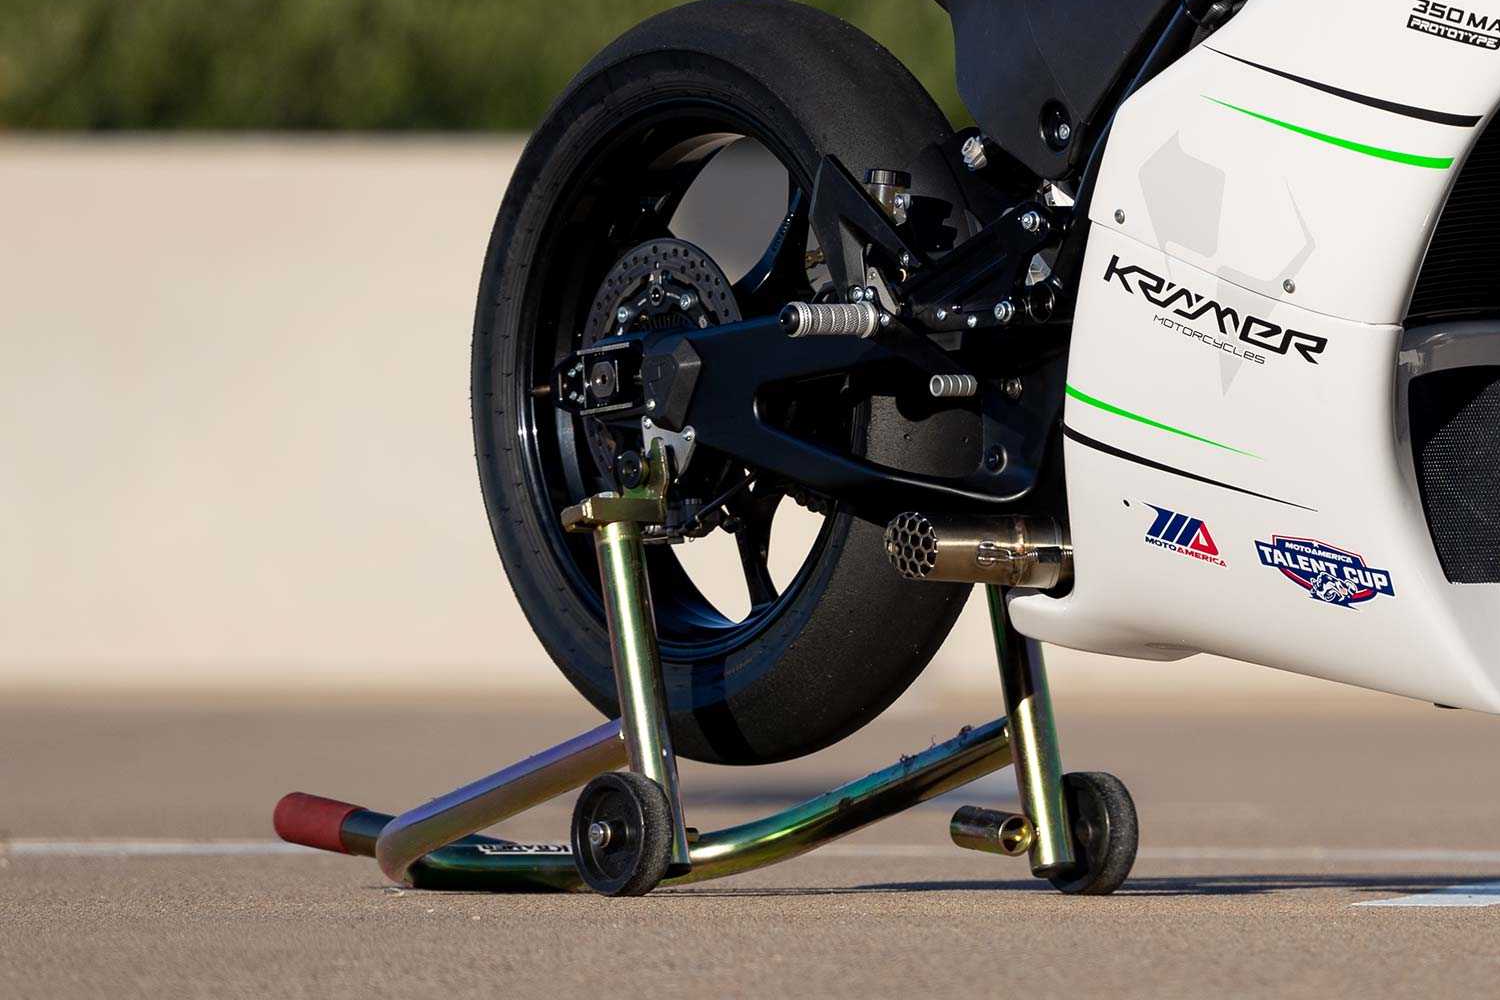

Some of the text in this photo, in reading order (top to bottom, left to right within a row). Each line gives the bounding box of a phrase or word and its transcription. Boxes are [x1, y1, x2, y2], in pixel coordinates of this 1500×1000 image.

[1409, 17, 1499, 49] PROTOTYPE
[1145, 536, 1227, 568] MOTOAMERICA
[1259, 545, 1389, 590] TALENT CUP
[1284, 541, 1353, 564] MOTOAMERICA
